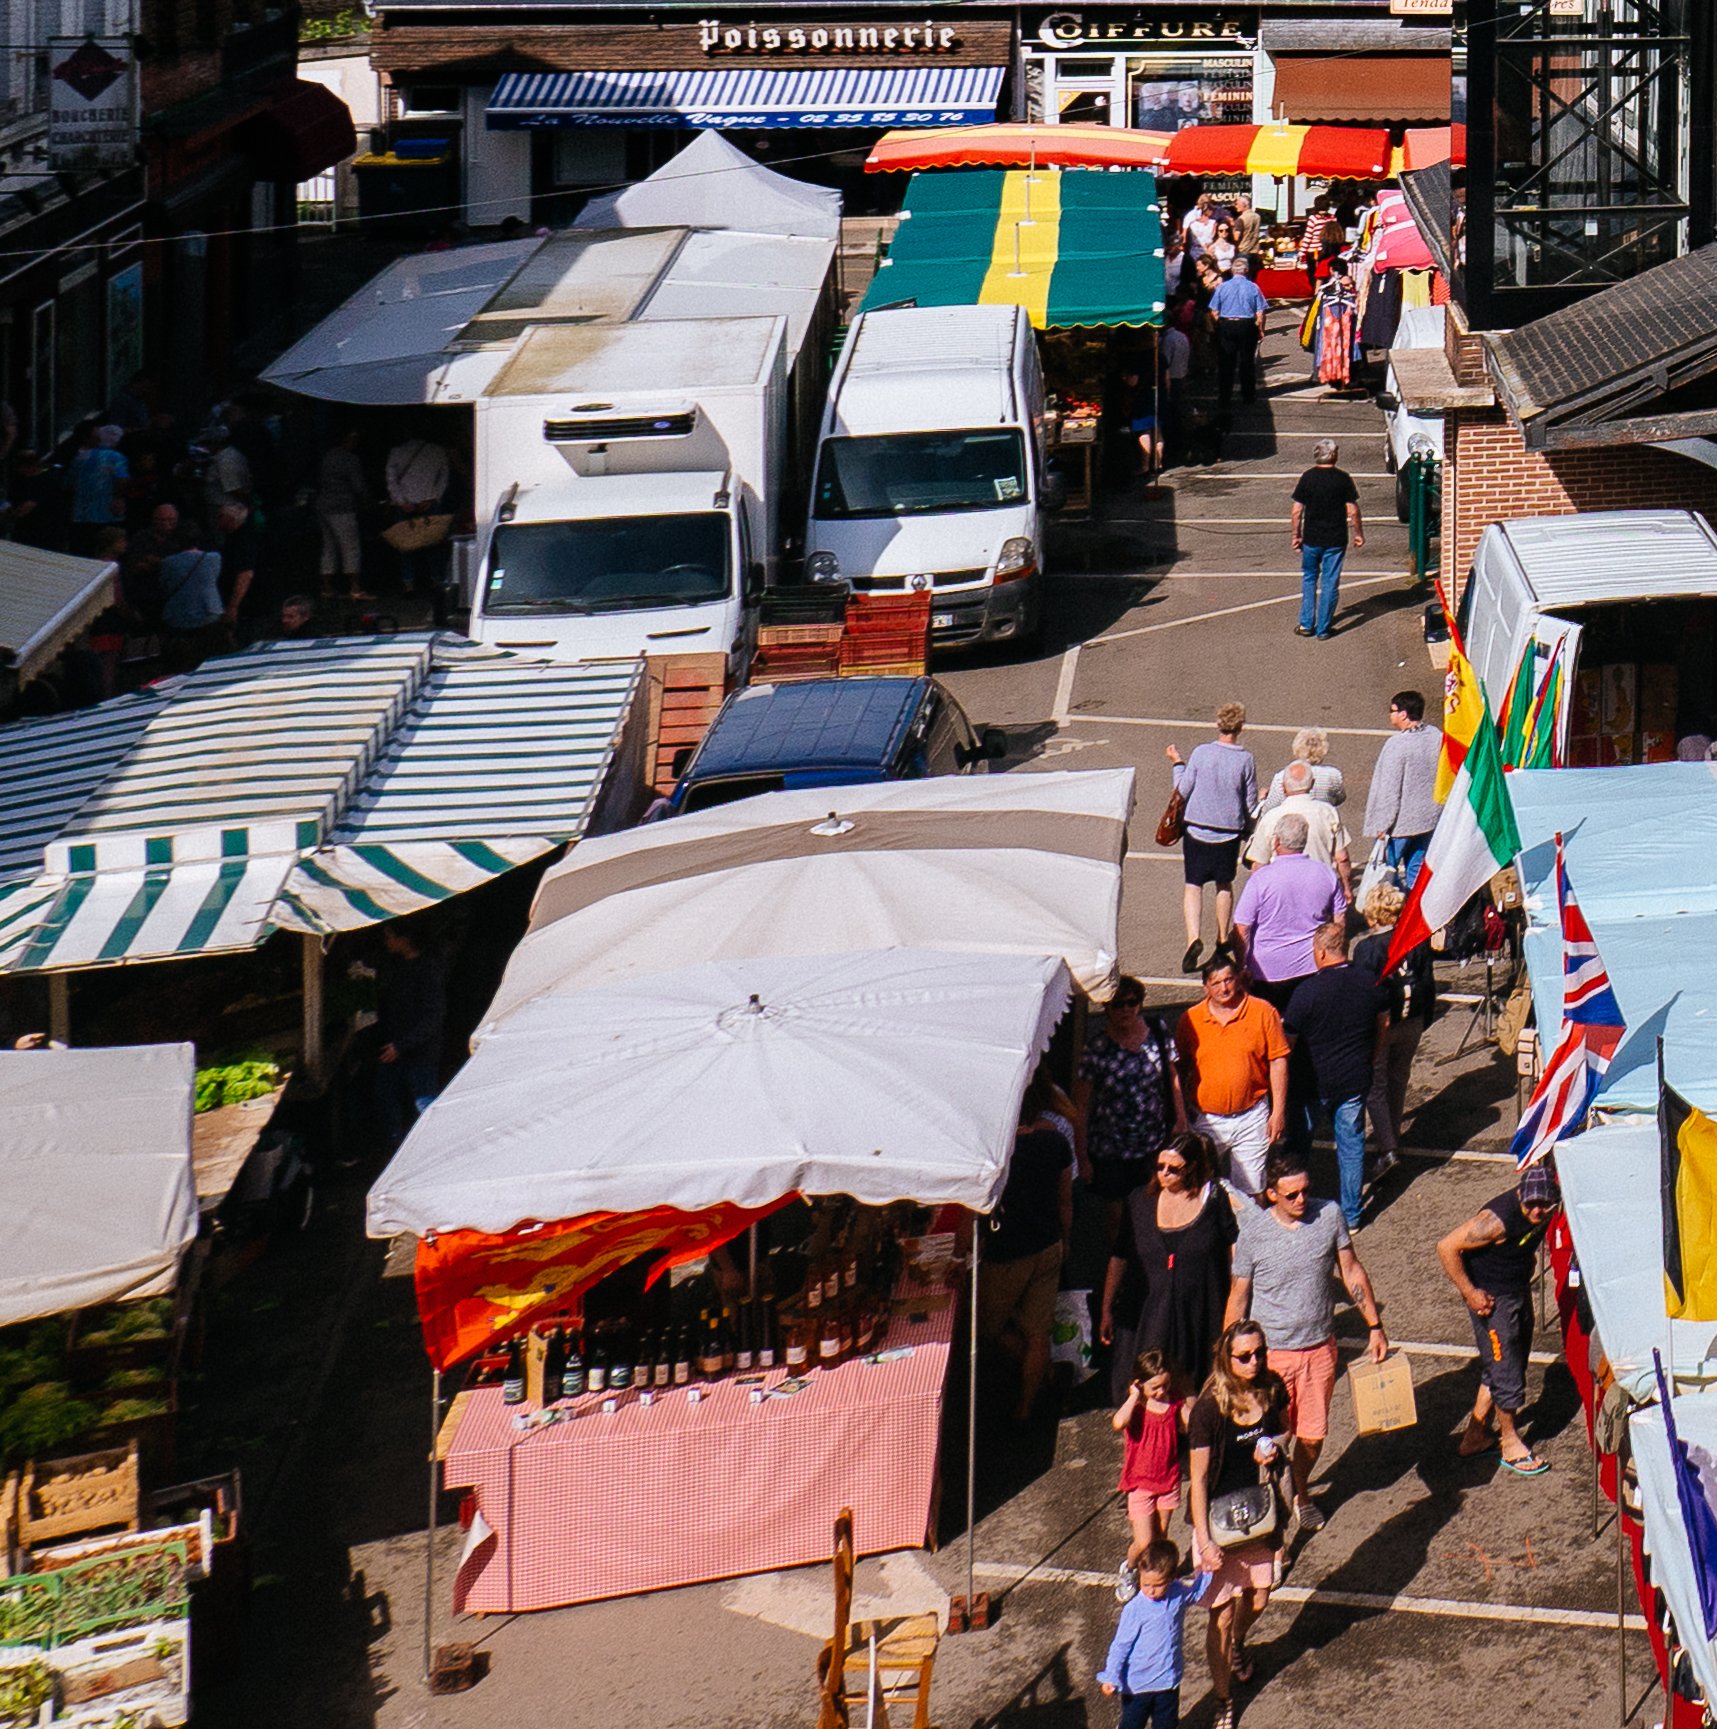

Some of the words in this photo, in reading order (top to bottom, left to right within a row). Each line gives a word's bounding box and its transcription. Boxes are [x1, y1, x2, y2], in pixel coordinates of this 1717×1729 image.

[699, 19, 956, 51] Poissonnerie
[1038, 12, 1242, 49] COIFFURE
[571, 113, 679, 125] Nouvelle
[685, 112, 767, 126] Vague
[799, 114, 829, 123] 02
[939, 112, 965, 122] 76
